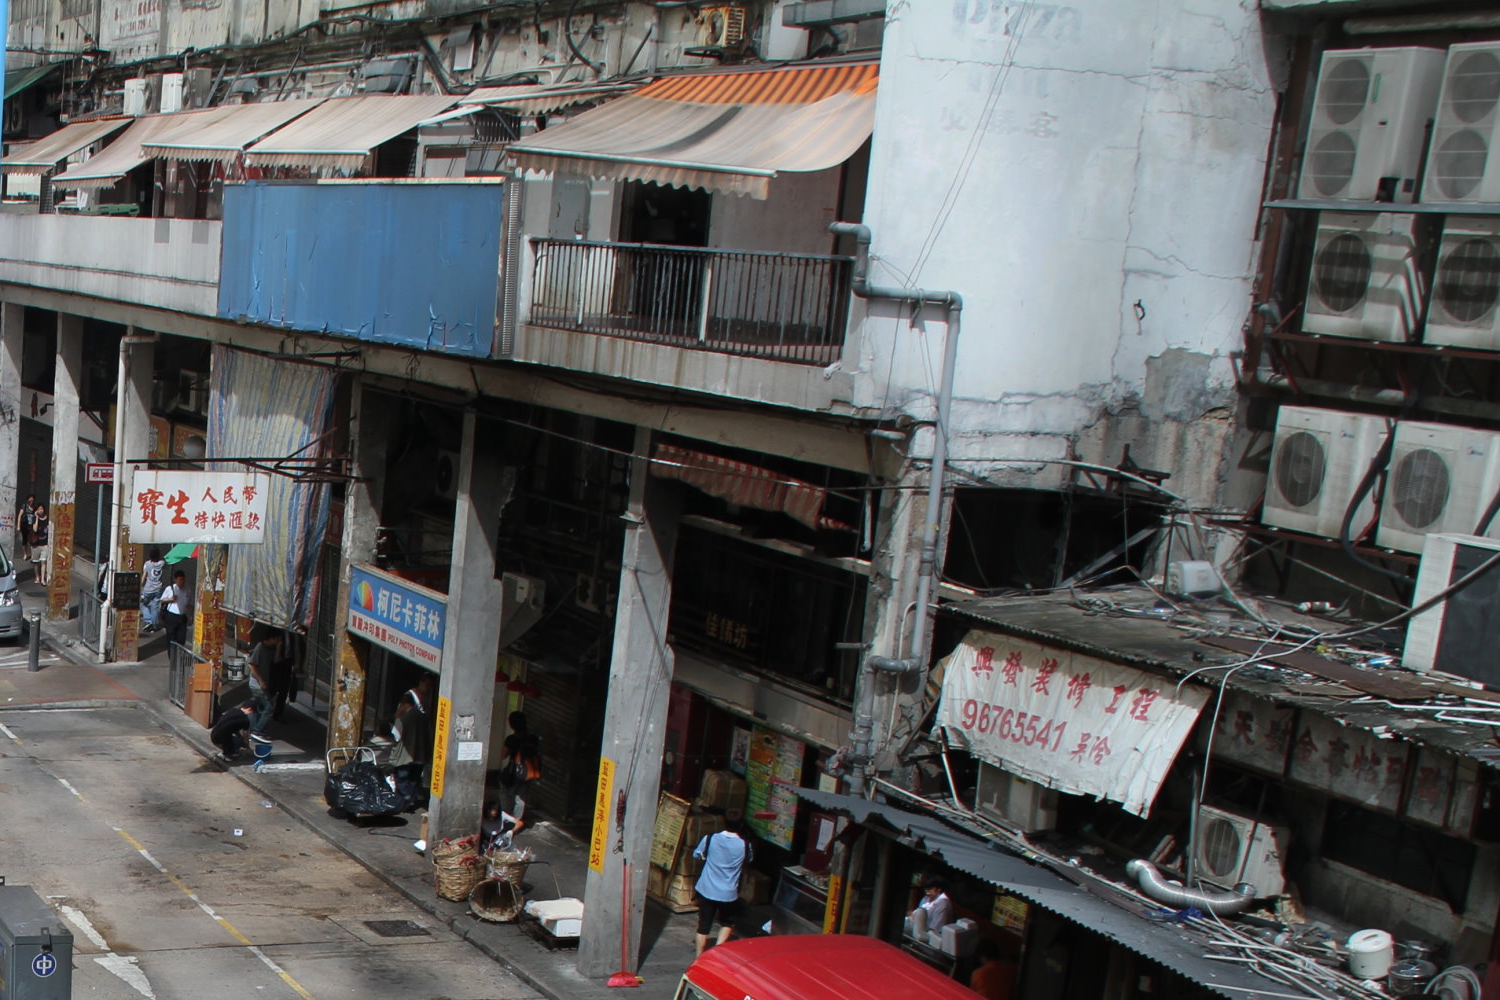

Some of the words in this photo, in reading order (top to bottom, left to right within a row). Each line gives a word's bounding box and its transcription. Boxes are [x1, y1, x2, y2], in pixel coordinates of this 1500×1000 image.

[137, 488, 190, 525] 寶生
[201, 486, 258, 506] 人民幣
[194, 511, 260, 530] 特快匯款
[378, 586, 440, 640] 柯尼卡菲林
[416, 647, 437, 662] COMPANY
[971, 646, 1161, 722] 興發裝修工程
[962, 699, 1067, 752] 96765541
